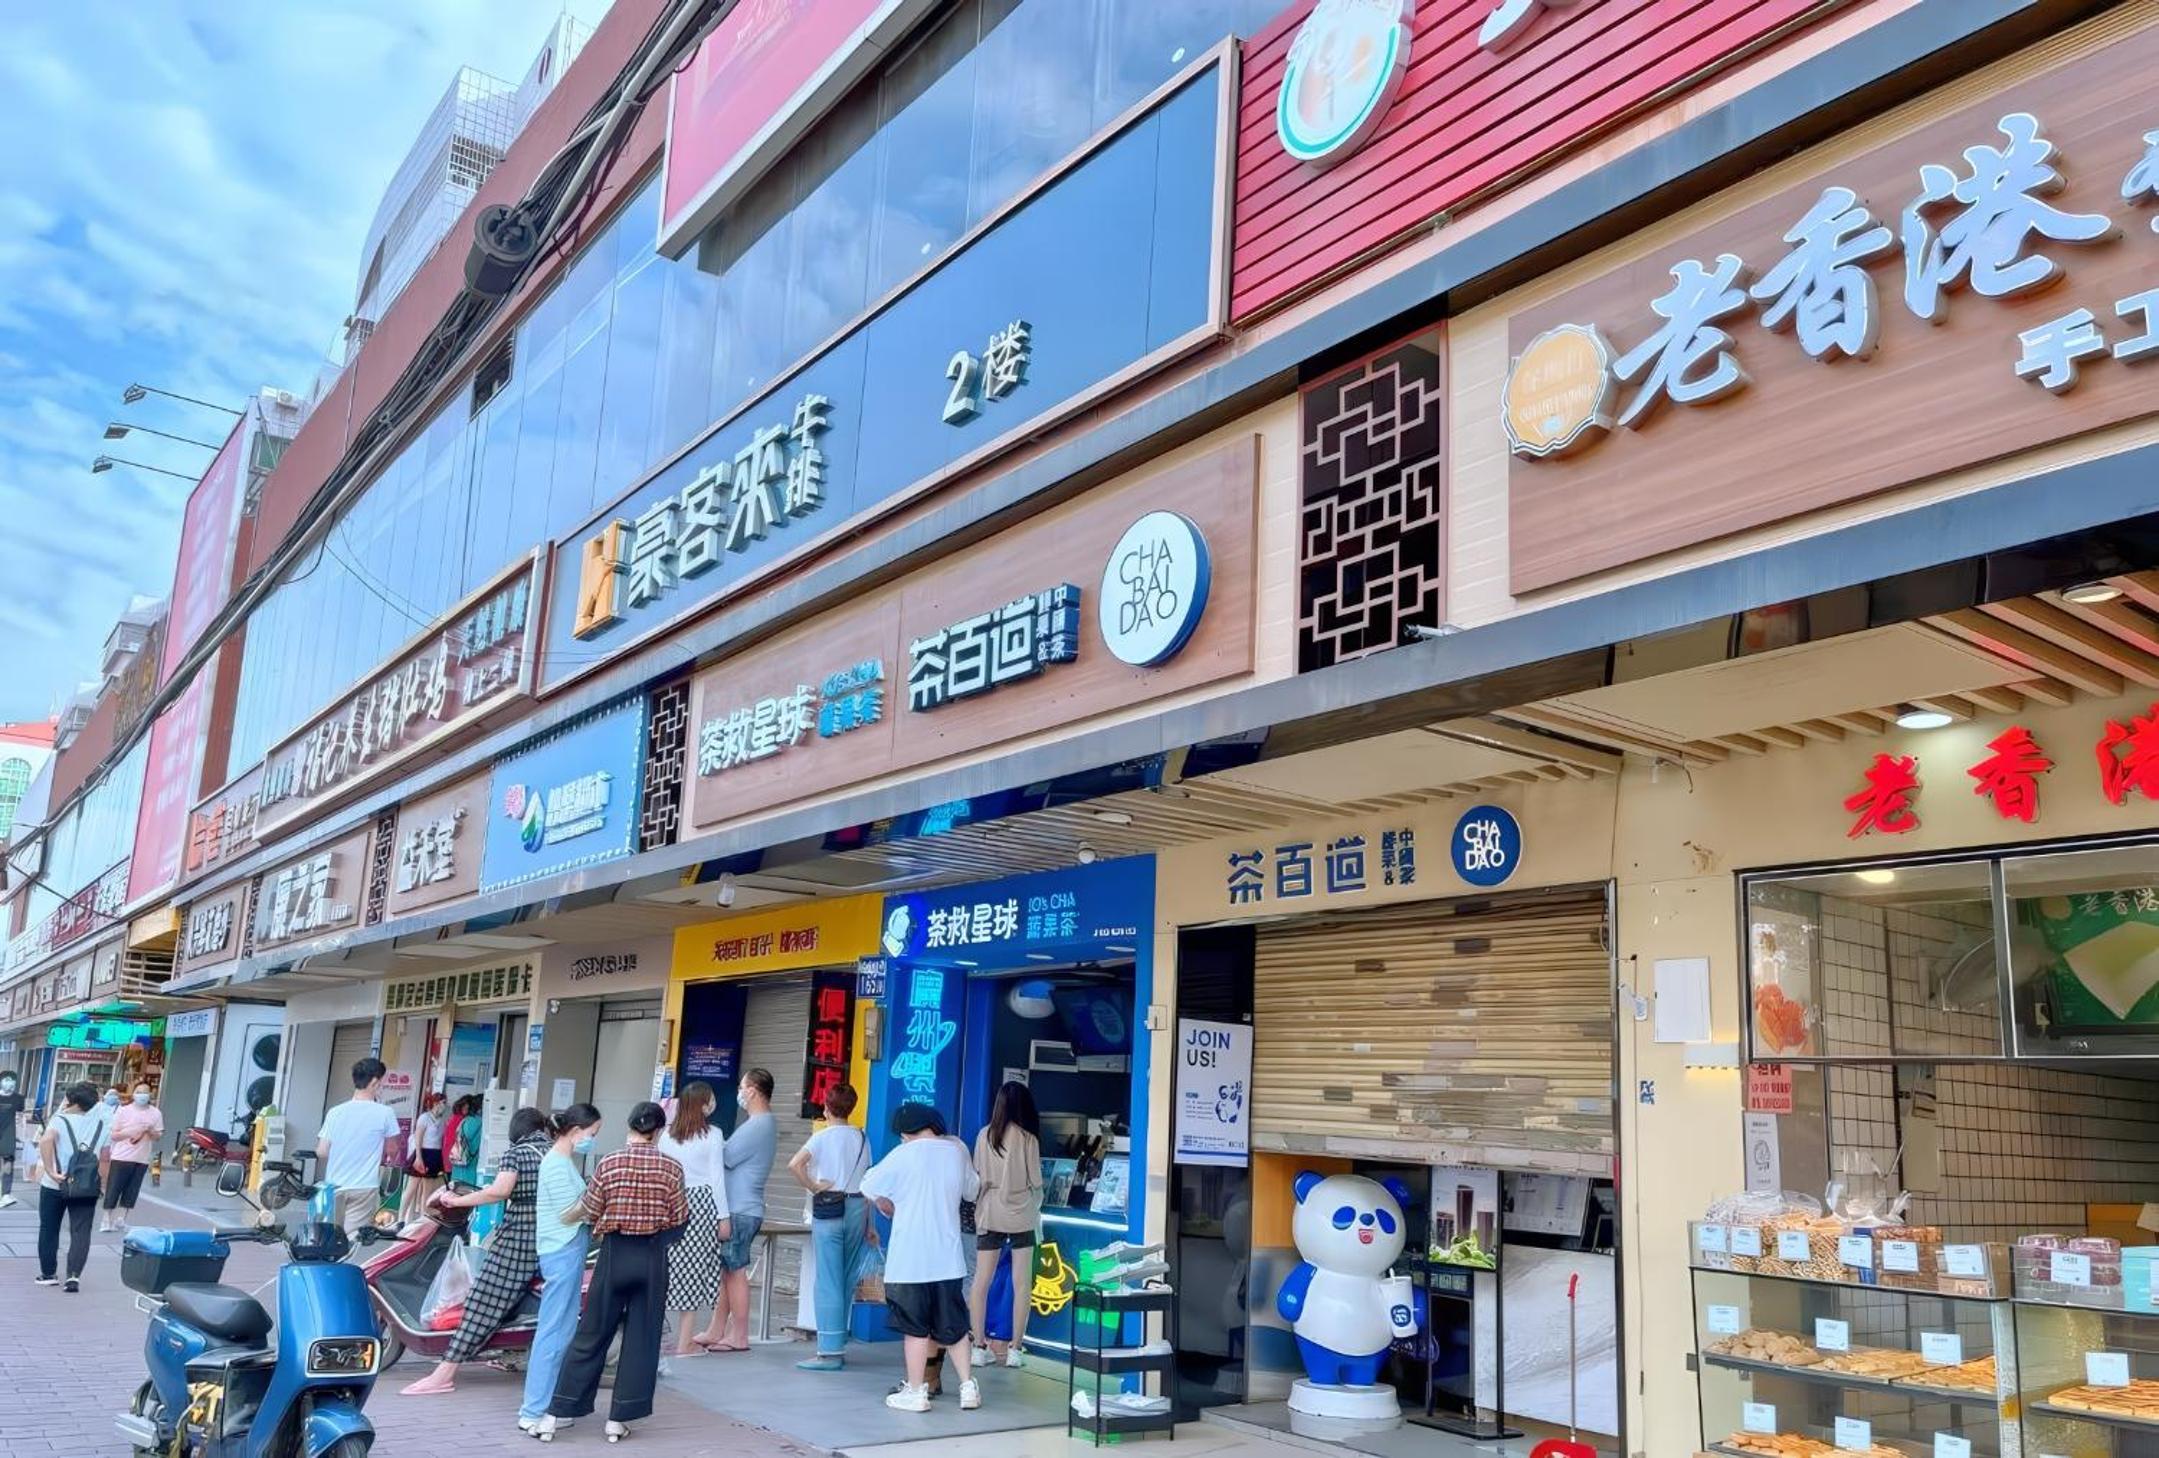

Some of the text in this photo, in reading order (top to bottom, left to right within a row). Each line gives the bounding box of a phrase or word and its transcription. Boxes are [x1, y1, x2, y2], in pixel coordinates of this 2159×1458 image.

[1611, 112, 2159, 428] 老香港
[942, 319, 1030, 424] 2楼
[1119, 538, 1173, 586] CHA
[1132, 564, 1171, 605] BAI
[1120, 590, 1178, 635] DAO
[908, 594, 1038, 713] 茶百道
[699, 684, 818, 777] 茶救星球
[1844, 703, 2159, 840] 老香港
[1464, 820, 1501, 843] CHA
[1474, 834, 1499, 853] BAI
[1227, 836, 1366, 904] 茶百道
[1465, 850, 1505, 870] DAO
[926, 898, 1019, 948] 茶救星球
[1186, 1028, 1231, 1050] JOIN
[1186, 1048, 1217, 1068] US!
